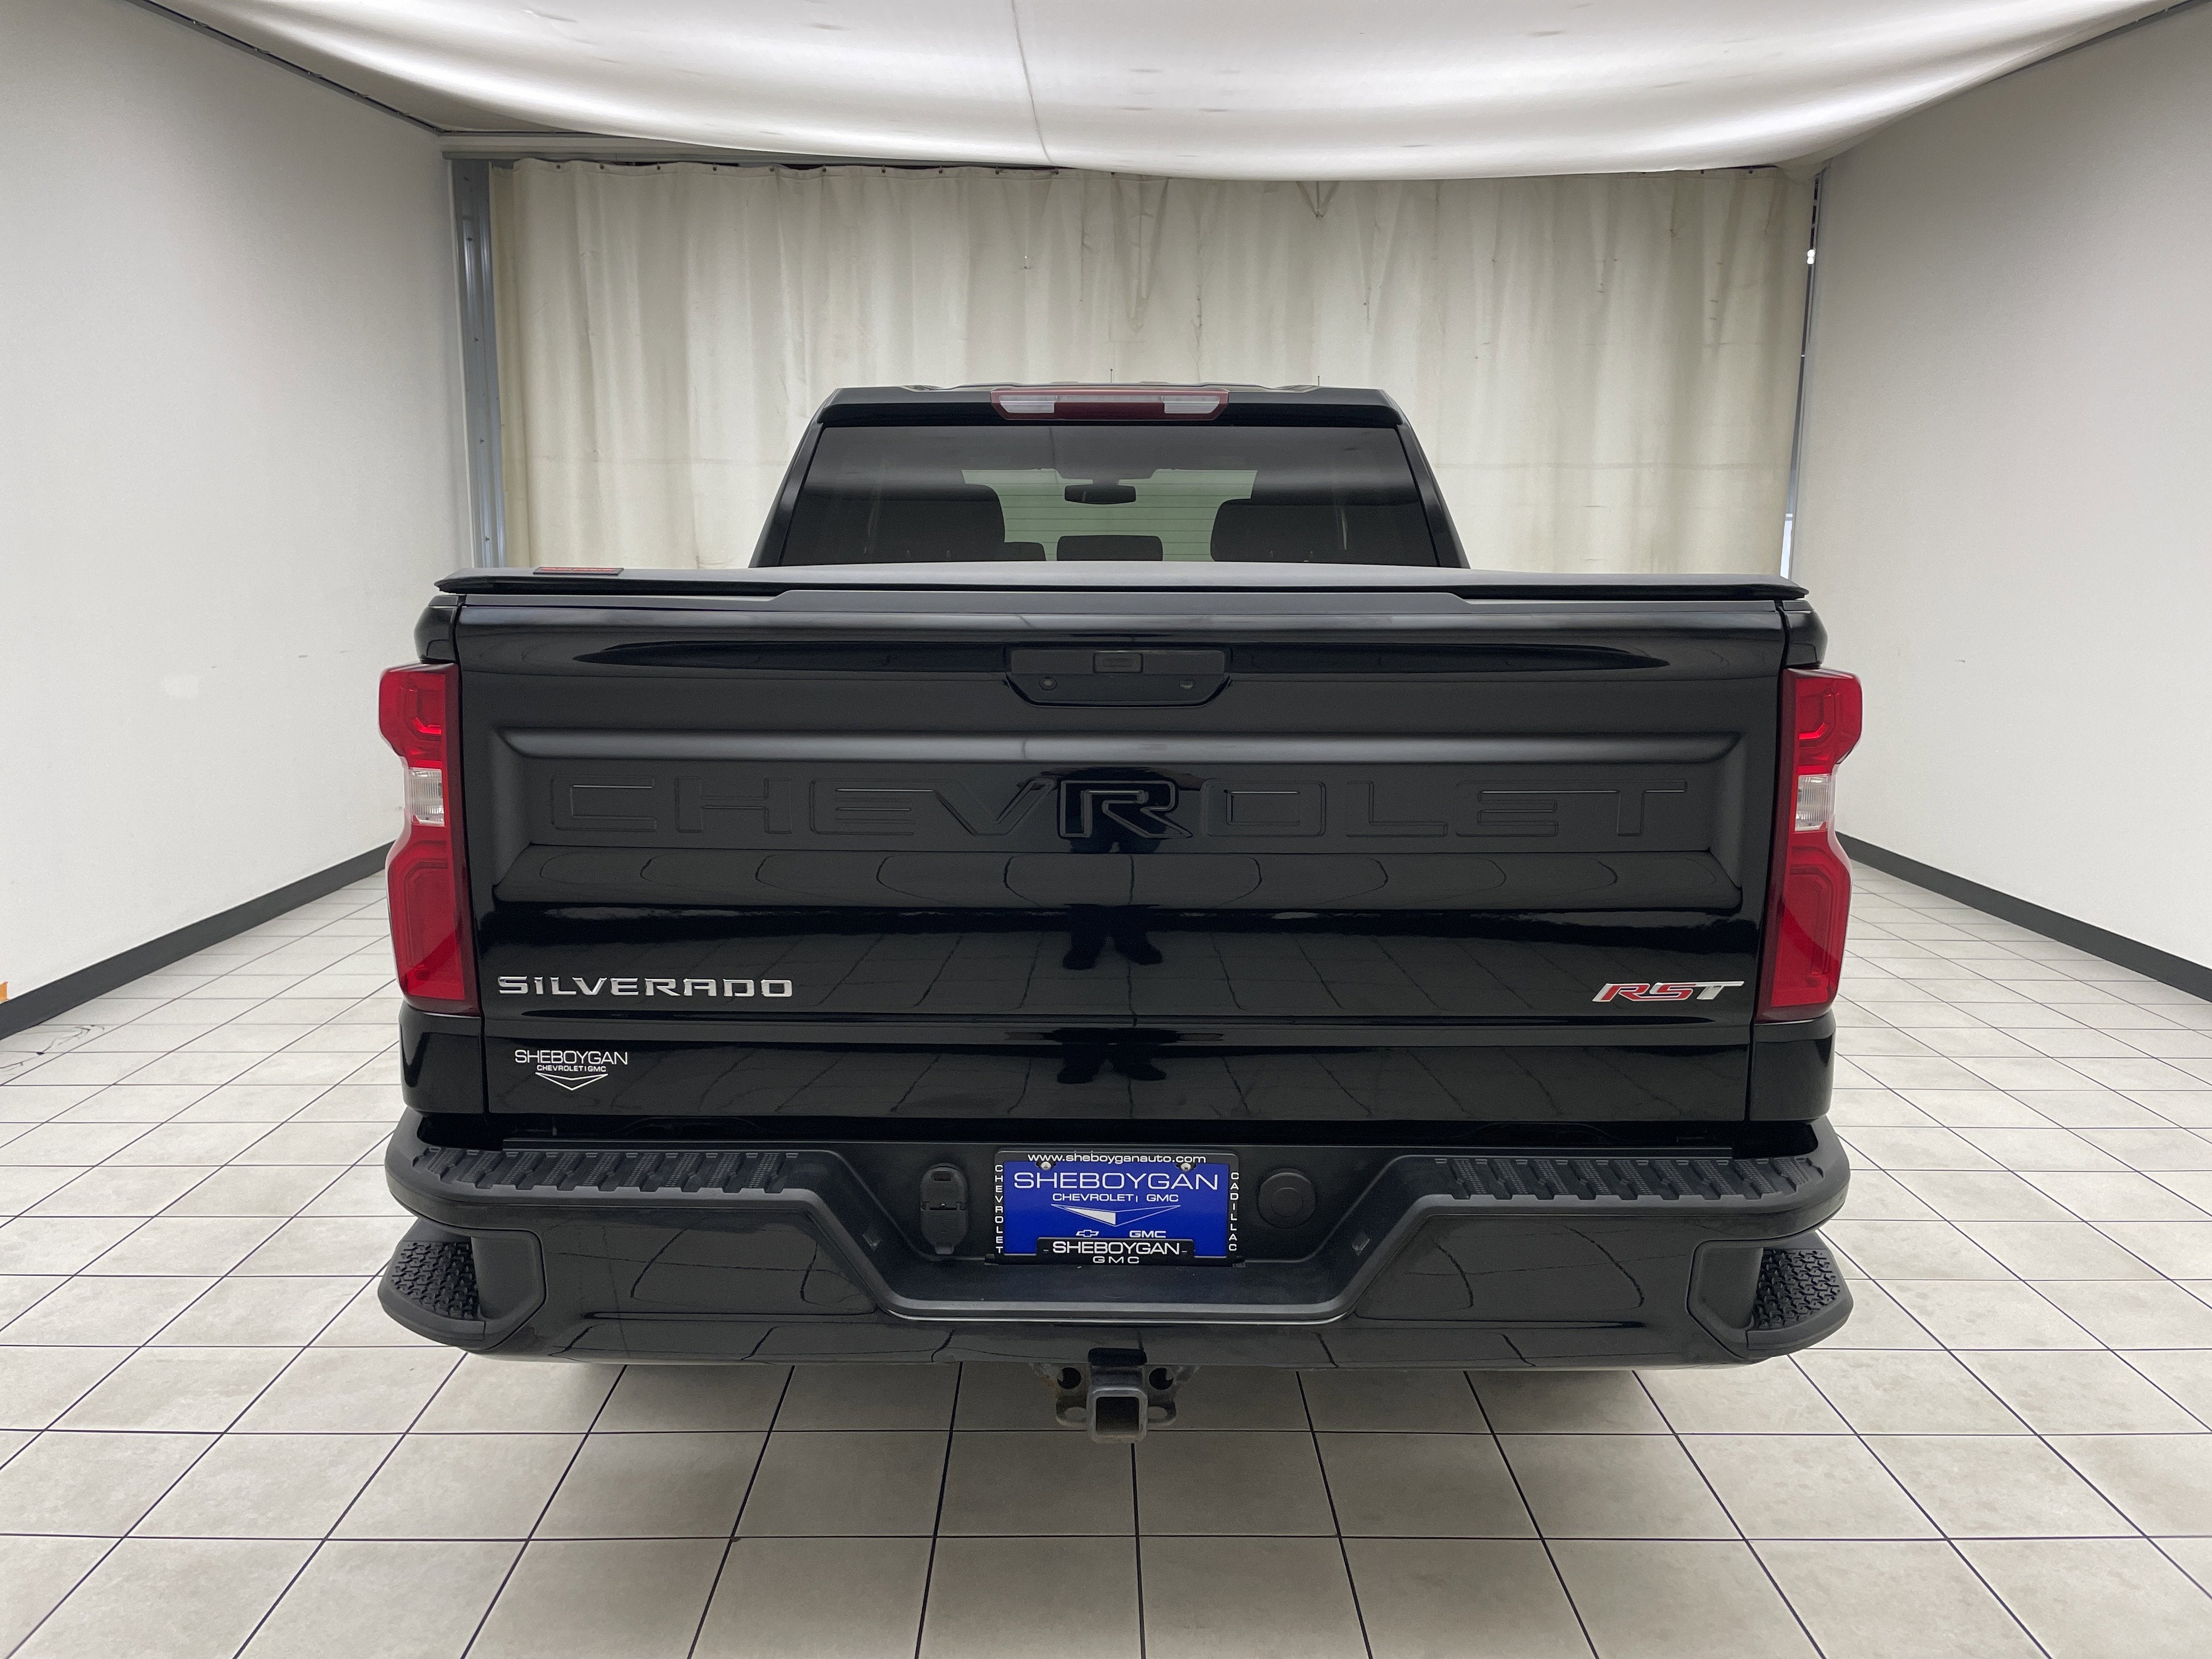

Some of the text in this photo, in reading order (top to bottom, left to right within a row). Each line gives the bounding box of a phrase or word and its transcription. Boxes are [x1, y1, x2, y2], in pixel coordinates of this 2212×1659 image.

[551, 774, 1688, 839] CHEVROLET
[497, 976, 793, 997] SILVERADO
[1592, 981, 1745, 1002] RST
[515, 1049, 628, 1065] SHEBOYGAN
[1028, 1153, 1206, 1164] www.sheboyganauto.com
[1013, 1172, 1218, 1190] SHEBOYGAN
[1052, 1193, 1179, 1203] CHEVROLET GMC
[995, 1164, 1004, 1254] CHEVROLET
[1228, 1172, 1239, 1251] CADILLAC
[1129, 1230, 1166, 1238] GMC
[1052, 1241, 1180, 1255] SHEBOYGAN
[1092, 1256, 1139, 1264] GMC
